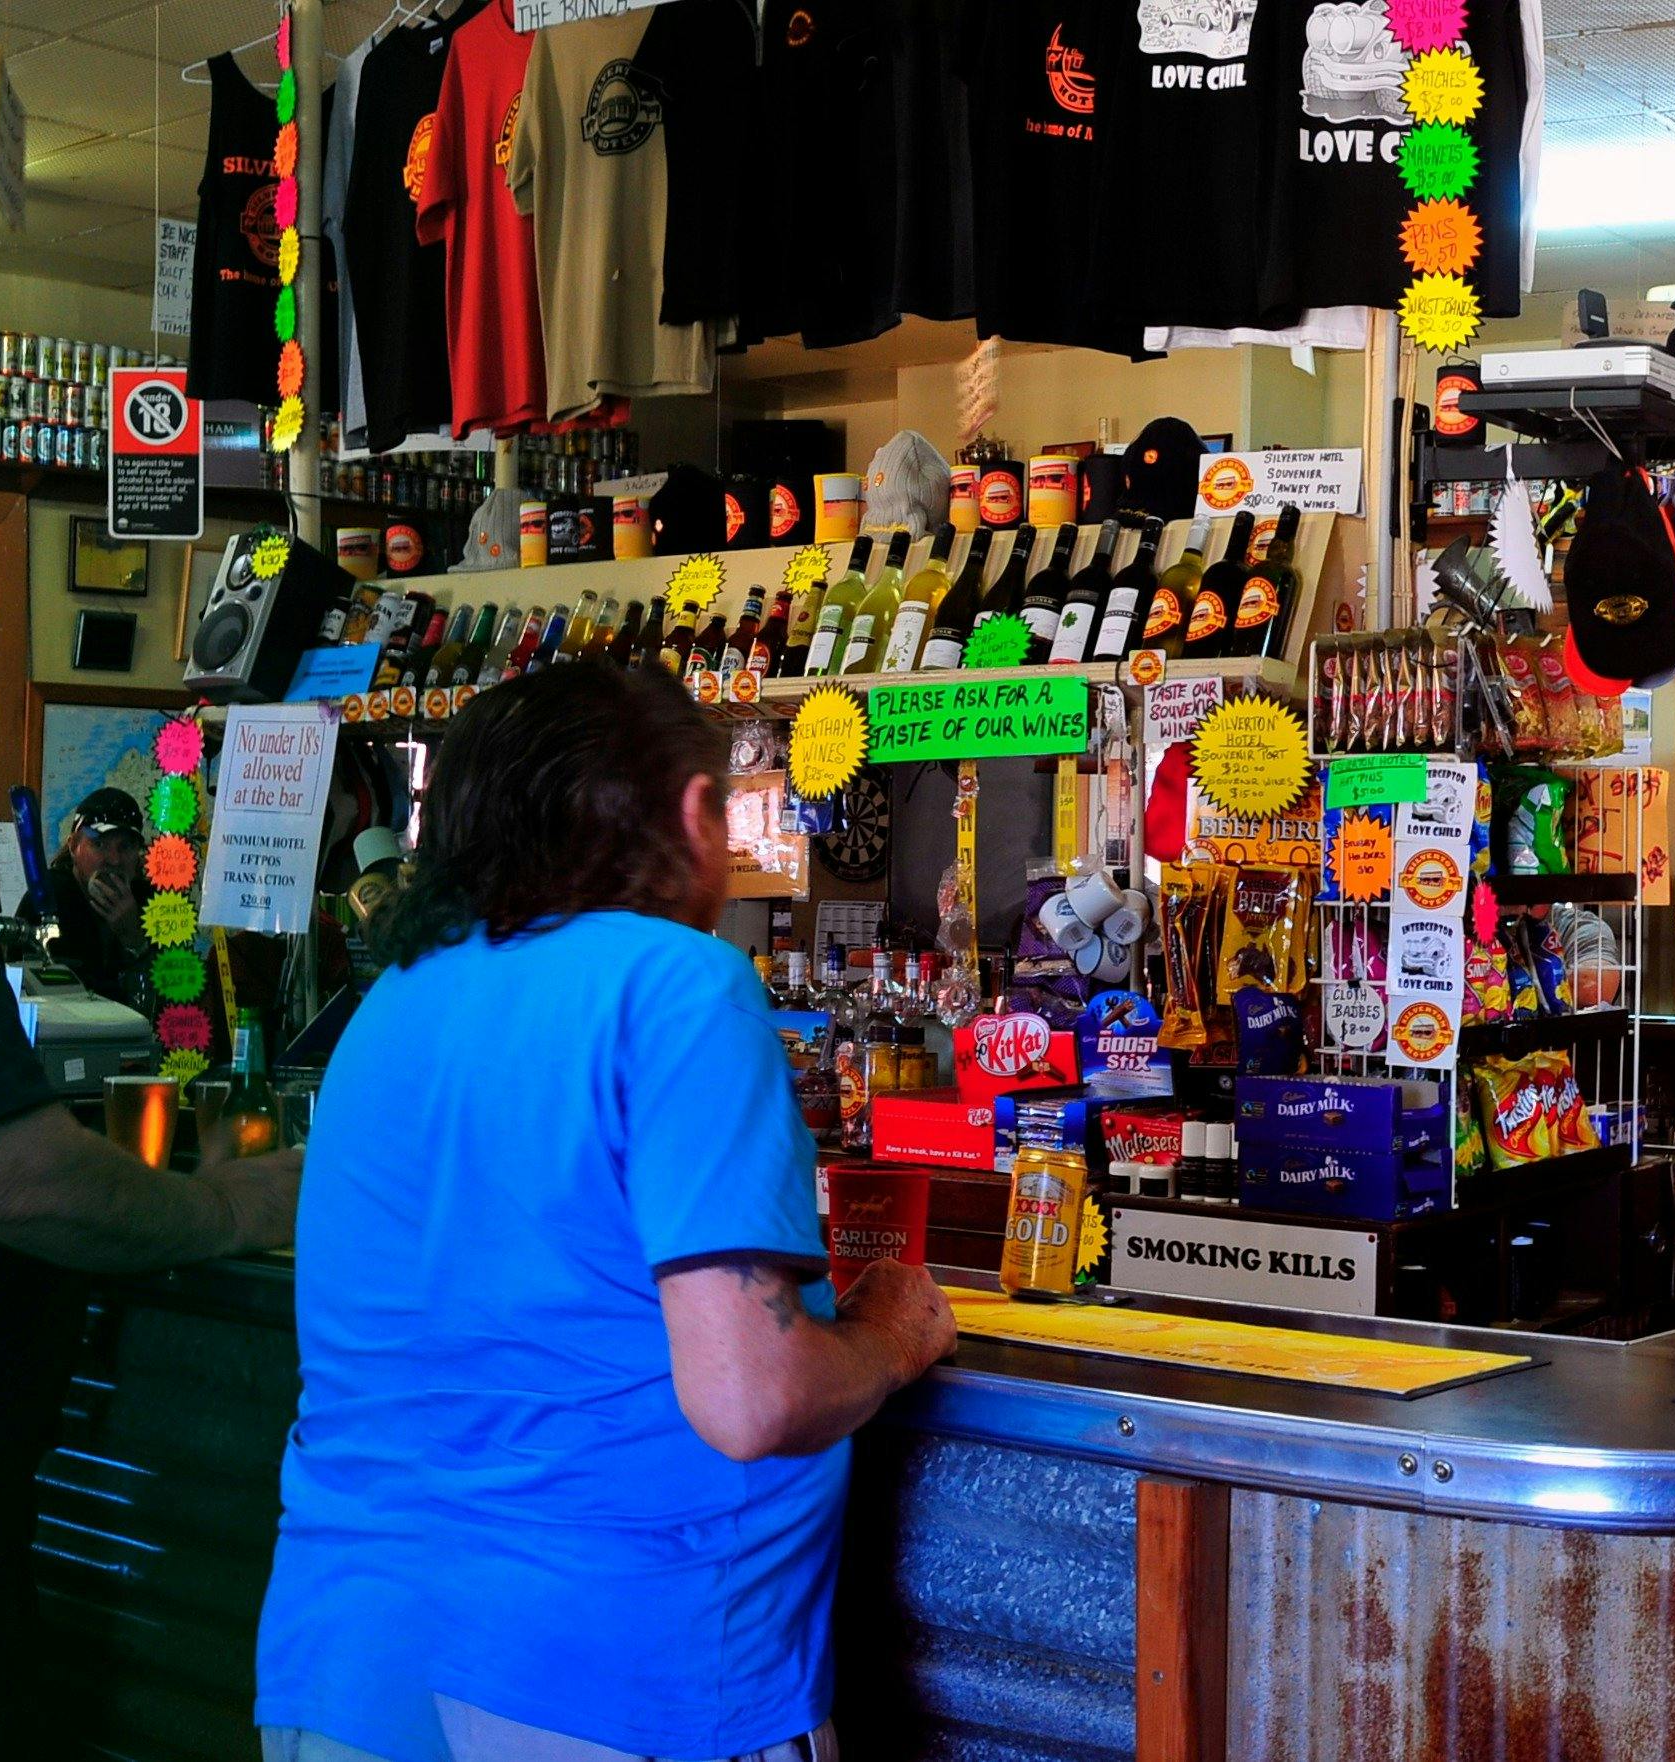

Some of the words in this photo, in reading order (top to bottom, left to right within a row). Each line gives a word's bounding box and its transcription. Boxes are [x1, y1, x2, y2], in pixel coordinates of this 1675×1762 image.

[517, 2, 551, 31] THE
[1151, 64, 1204, 89] LOVE
[1299, 128, 1374, 164] LOVE
[1409, 219, 1458, 249] PENS
[219, 268, 241, 281] The
[138, 403, 171, 434] 18
[1264, 452, 1315, 465] SILVERTON
[1319, 453, 1345, 463] HOTEL
[1266, 466, 1323, 479] SOUVENIER
[1271, 481, 1310, 494] TAWNEY
[1316, 482, 1342, 494] PORT
[875, 690, 945, 719] PLEASE
[952, 685, 989, 709] ASK
[994, 684, 1029, 708] FOR
[1035, 681, 1054, 705] A
[1148, 683, 1187, 702] TASTE
[1193, 681, 1219, 699] OUR
[868, 719, 932, 750] TASTE
[942, 717, 967, 741] OF
[975, 715, 1018, 740] OUR
[1023, 711, 1086, 739] WINES
[1210, 716, 1276, 732] SILVERTON
[237, 724, 256, 755] No
[258, 726, 295, 756] under
[298, 726, 320, 756] 18's
[1226, 733, 1264, 747] HOTEL
[803, 741, 846, 764] WINES
[1200, 749, 1255, 763] SOUVENIR
[1262, 747, 1288, 760] PORT
[242, 757, 304, 781] allowed
[233, 787, 247, 804] at
[251, 784, 274, 806] the
[279, 785, 303, 807] bar
[1198, 817, 1262, 840] BEEF
[1407, 823, 1430, 836] LOVE
[1433, 826, 1462, 838] CHILD
[222, 833, 271, 847] MINIMUM
[273, 836, 306, 850] HOTEL
[240, 853, 281, 867] EFTPOS
[223, 870, 296, 887] TRANSACTION
[1401, 921, 1453, 938] INTERCEPTOR
[1397, 978, 1422, 990] LOVE
[1424, 980, 1454, 992] CHILD
[1333, 988, 1367, 1001] CLOTH
[1331, 1003, 1381, 1020] BADGES
[1096, 1035, 1158, 1053] BOOST
[1278, 1103, 1317, 1117] DAIRY
[1317, 1099, 1355, 1114] MILK
[1105, 1132, 1180, 1163] Maltesers
[1280, 1170, 1316, 1183] DAIRY
[1318, 1167, 1355, 1181] MILK
[1015, 1200, 1057, 1217] XXXX
[831, 1228, 906, 1247] CARLTON
[1005, 1217, 1069, 1246] GOLD
[834, 1244, 902, 1260] DRAUGHT
[1126, 1235, 1262, 1272] SMOKING
[1268, 1250, 1356, 1281] KILLS
